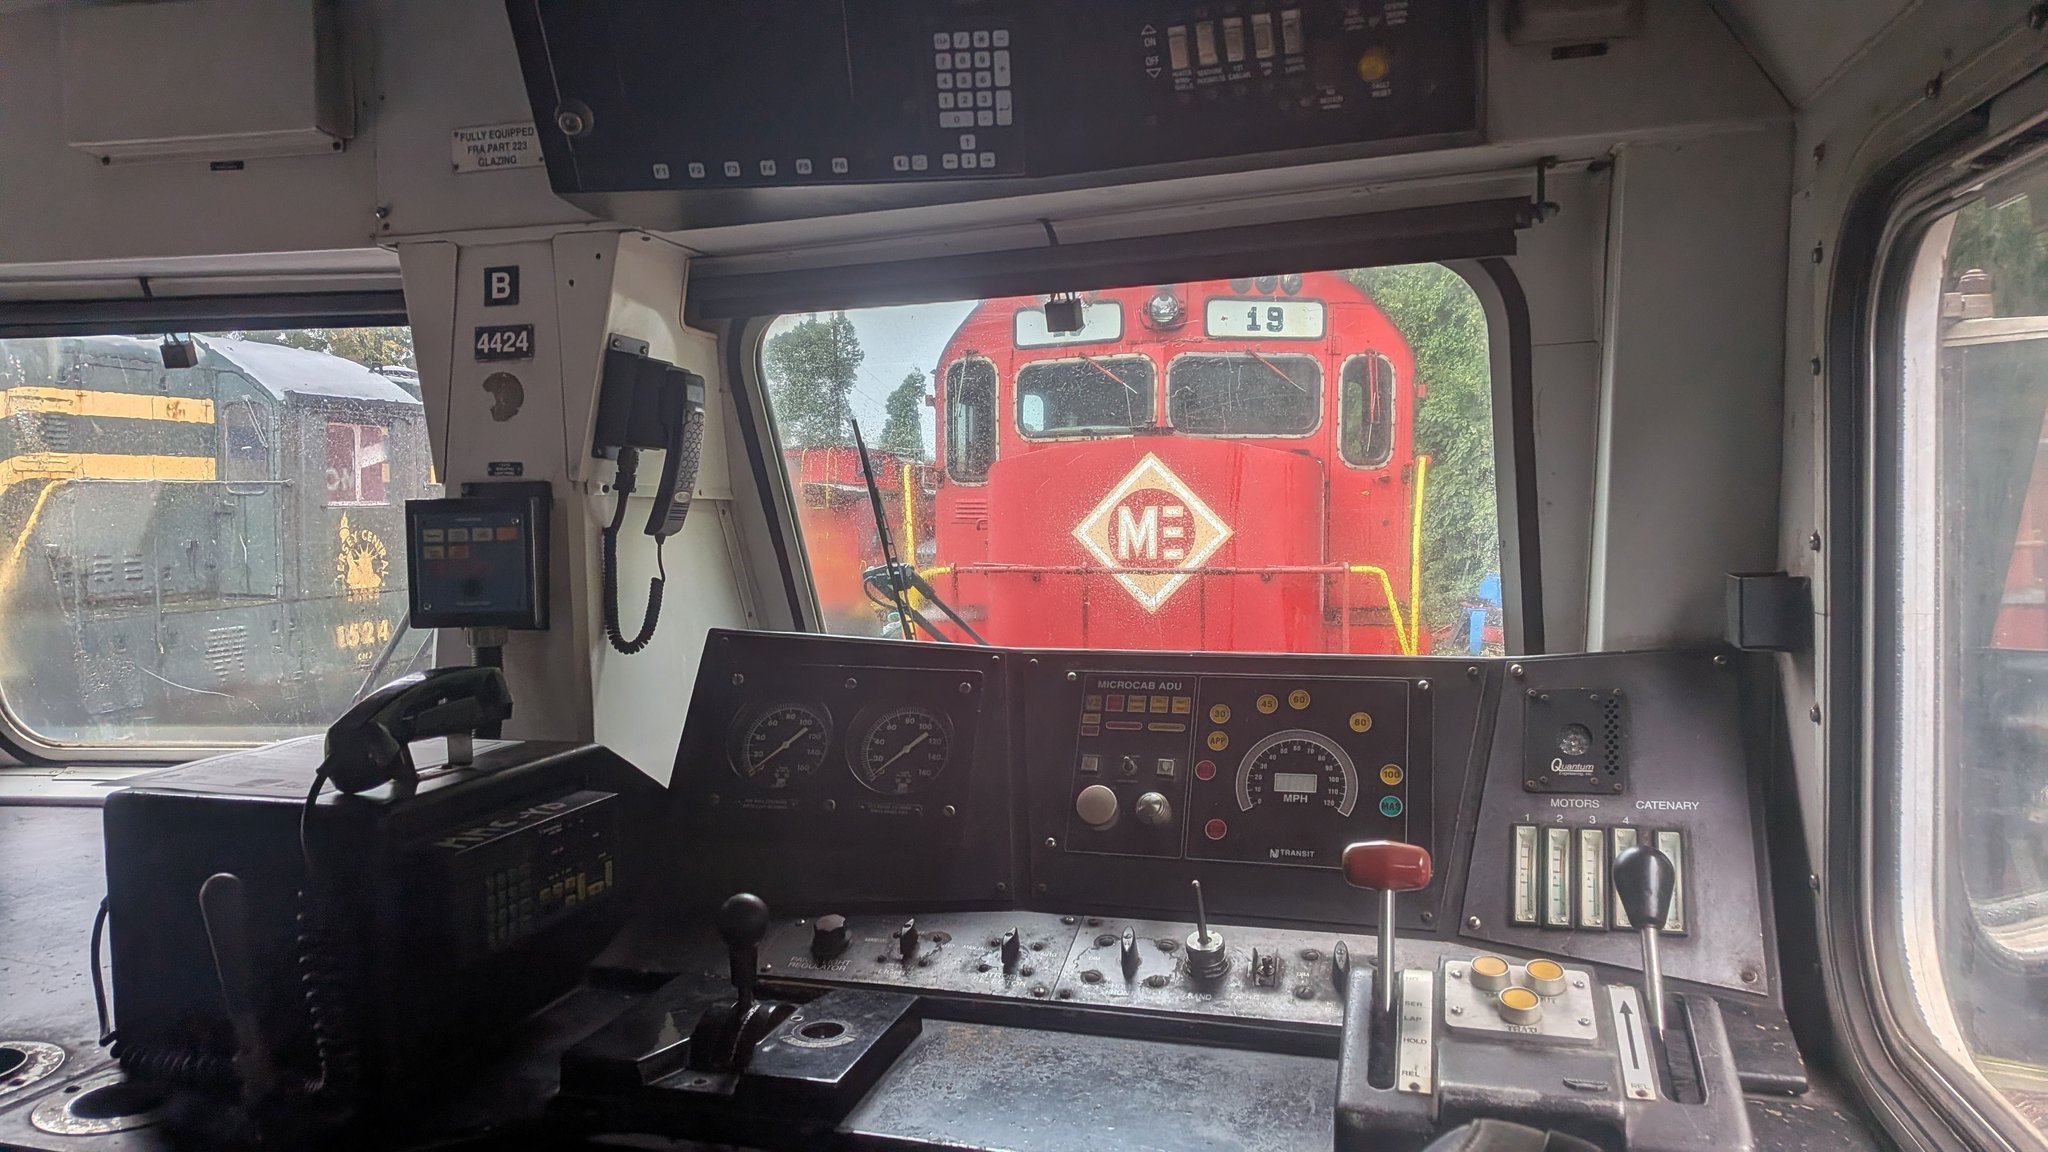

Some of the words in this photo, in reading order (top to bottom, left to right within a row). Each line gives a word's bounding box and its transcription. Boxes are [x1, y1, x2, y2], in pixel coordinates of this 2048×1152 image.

[1143, 38, 1156, 47] ON
[1145, 56, 1160, 66] OFF
[460, 131, 486, 142] FULLY
[490, 127, 534, 139] EQUIPPED
[467, 145, 485, 154] FRA
[487, 142, 510, 153] PART
[512, 141, 528, 150] 223
[478, 155, 517, 167] GLAZING
[491, 272, 511, 300] B
[1247, 306, 1284, 333] 19
[476, 330, 530, 354] 4424
[336, 530, 358, 583] JERSEY
[361, 529, 389, 578] CENTRAL
[1098, 680, 1155, 690] MICROCAB
[1158, 682, 1182, 691] ADU
[1261, 700, 1273, 708] 45
[1293, 696, 1305, 704] 60
[1214, 710, 1226, 718] 30
[768, 719, 778, 727] 60
[1209, 737, 1226, 745] APP
[1551, 758, 1595, 773] Quantum
[1383, 771, 1400, 779] 100
[1283, 794, 1308, 803] MPH
[1550, 798, 1600, 809] MOTORS
[1635, 800, 1700, 811] CATENARY
[1524, 813, 1531, 822] 1
[1556, 814, 1564, 823] 2
[1589, 815, 1597, 824] 3
[1622, 816, 1630, 825] 4
[1280, 848, 1316, 858] TRANSIT
[787, 961, 847, 972] REGULATOR
[1403, 1037, 1428, 1045] HOLD
[1401, 1070, 1421, 1078] REL
